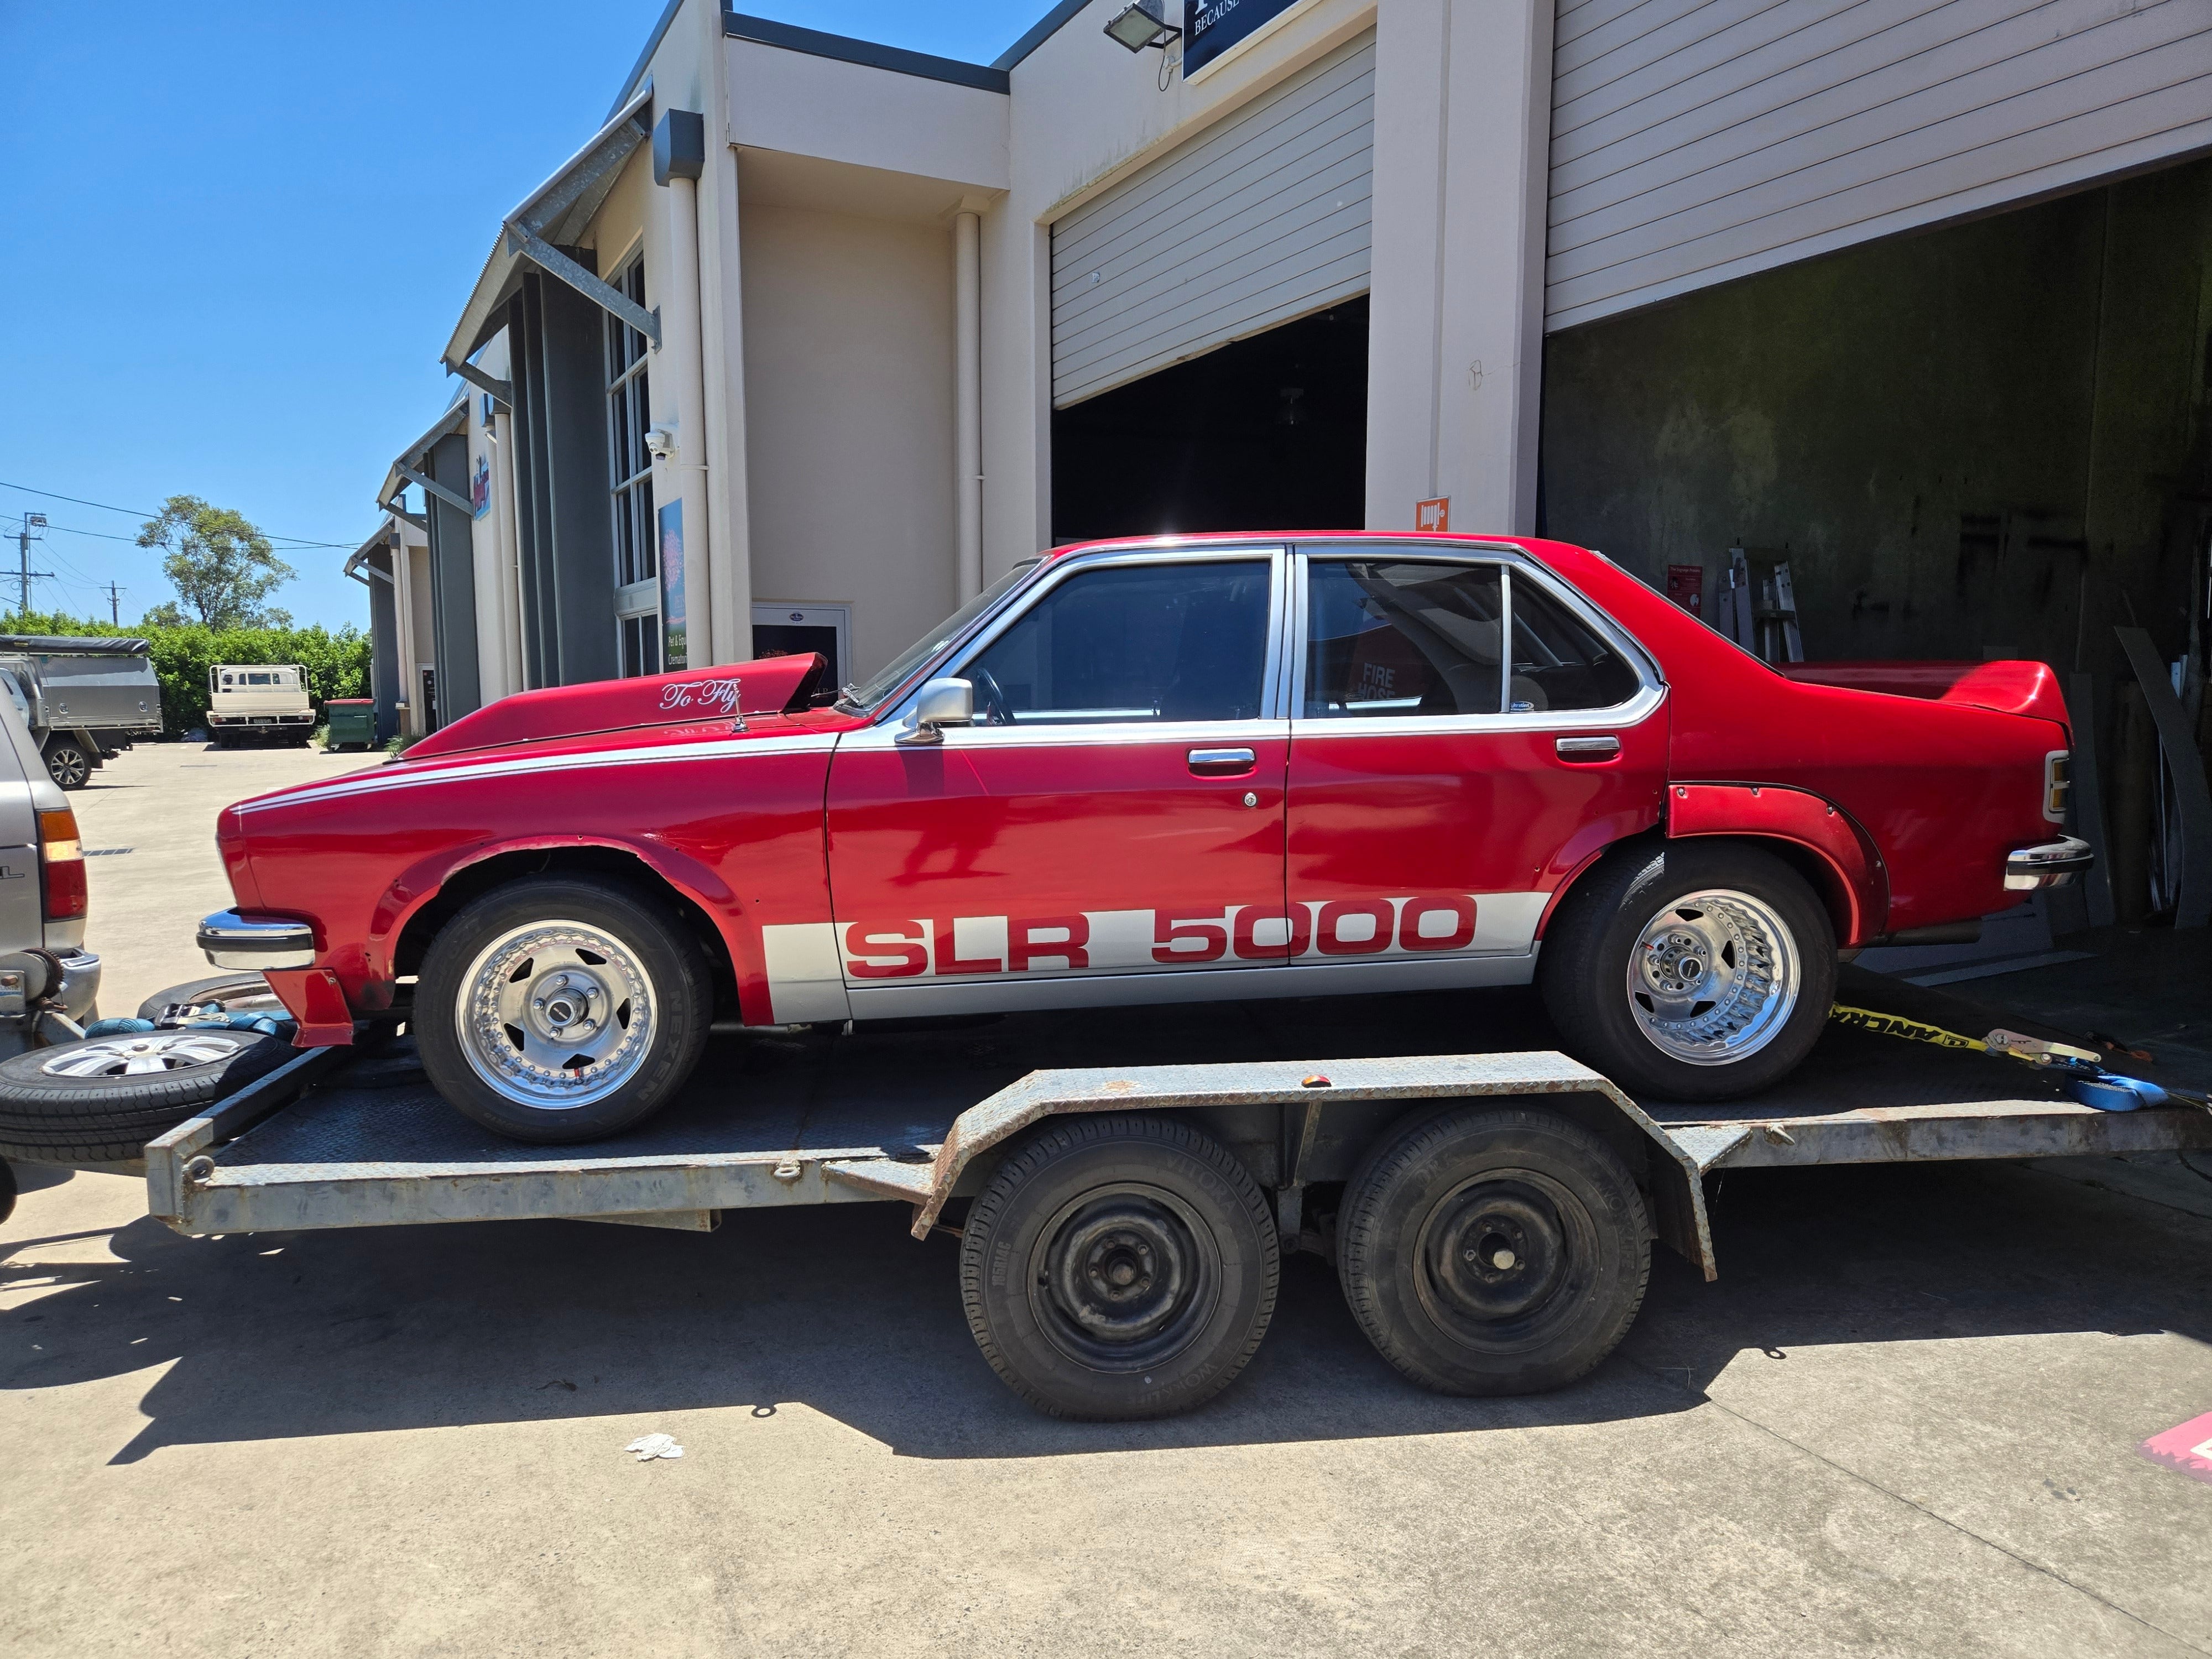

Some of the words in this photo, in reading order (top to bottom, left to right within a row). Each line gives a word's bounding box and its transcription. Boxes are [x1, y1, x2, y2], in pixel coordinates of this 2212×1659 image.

[1195, 0, 1239, 36] BECAUSE
[659, 683, 702, 709] To
[697, 678, 742, 713] Fly
[1363, 662, 1395, 688] FIRE
[846, 912, 1089, 978] SLR
[1151, 895, 1478, 963] 5000
[638, 990, 684, 1101] NEXEN
[1165, 1152, 1238, 1212] VITORA
